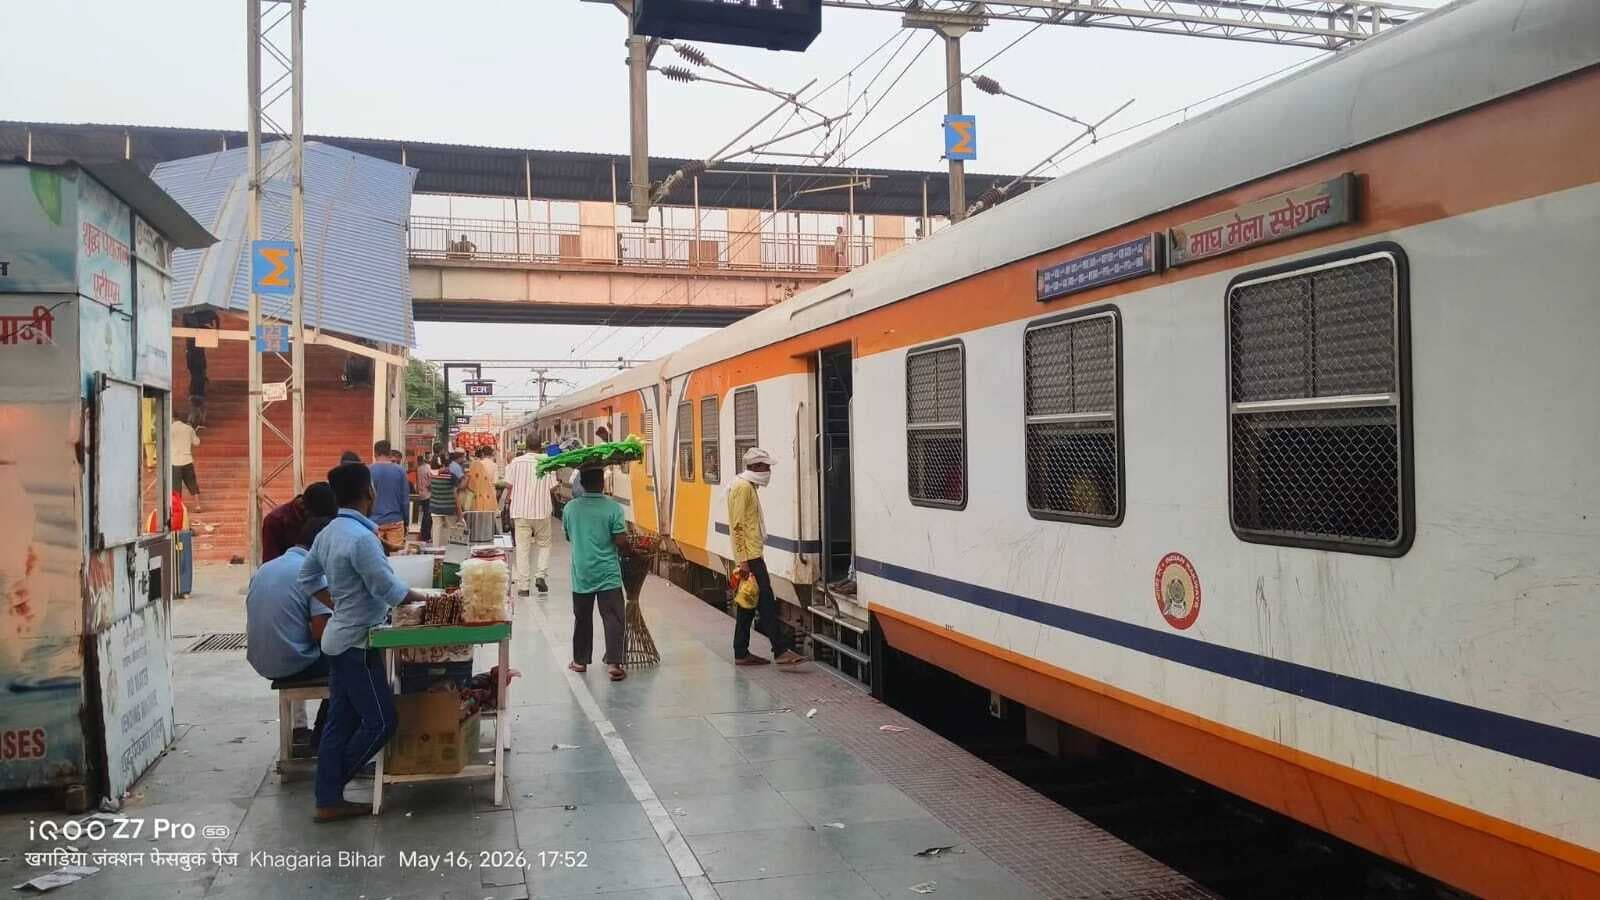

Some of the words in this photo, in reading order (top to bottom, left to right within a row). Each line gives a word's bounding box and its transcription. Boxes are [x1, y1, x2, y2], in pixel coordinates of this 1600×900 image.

[1190, 227, 1222, 255] माघ
[1227, 214, 1265, 245] मेला
[1269, 196, 1330, 235] स्पेशल
[0, 729, 45, 758] SES
